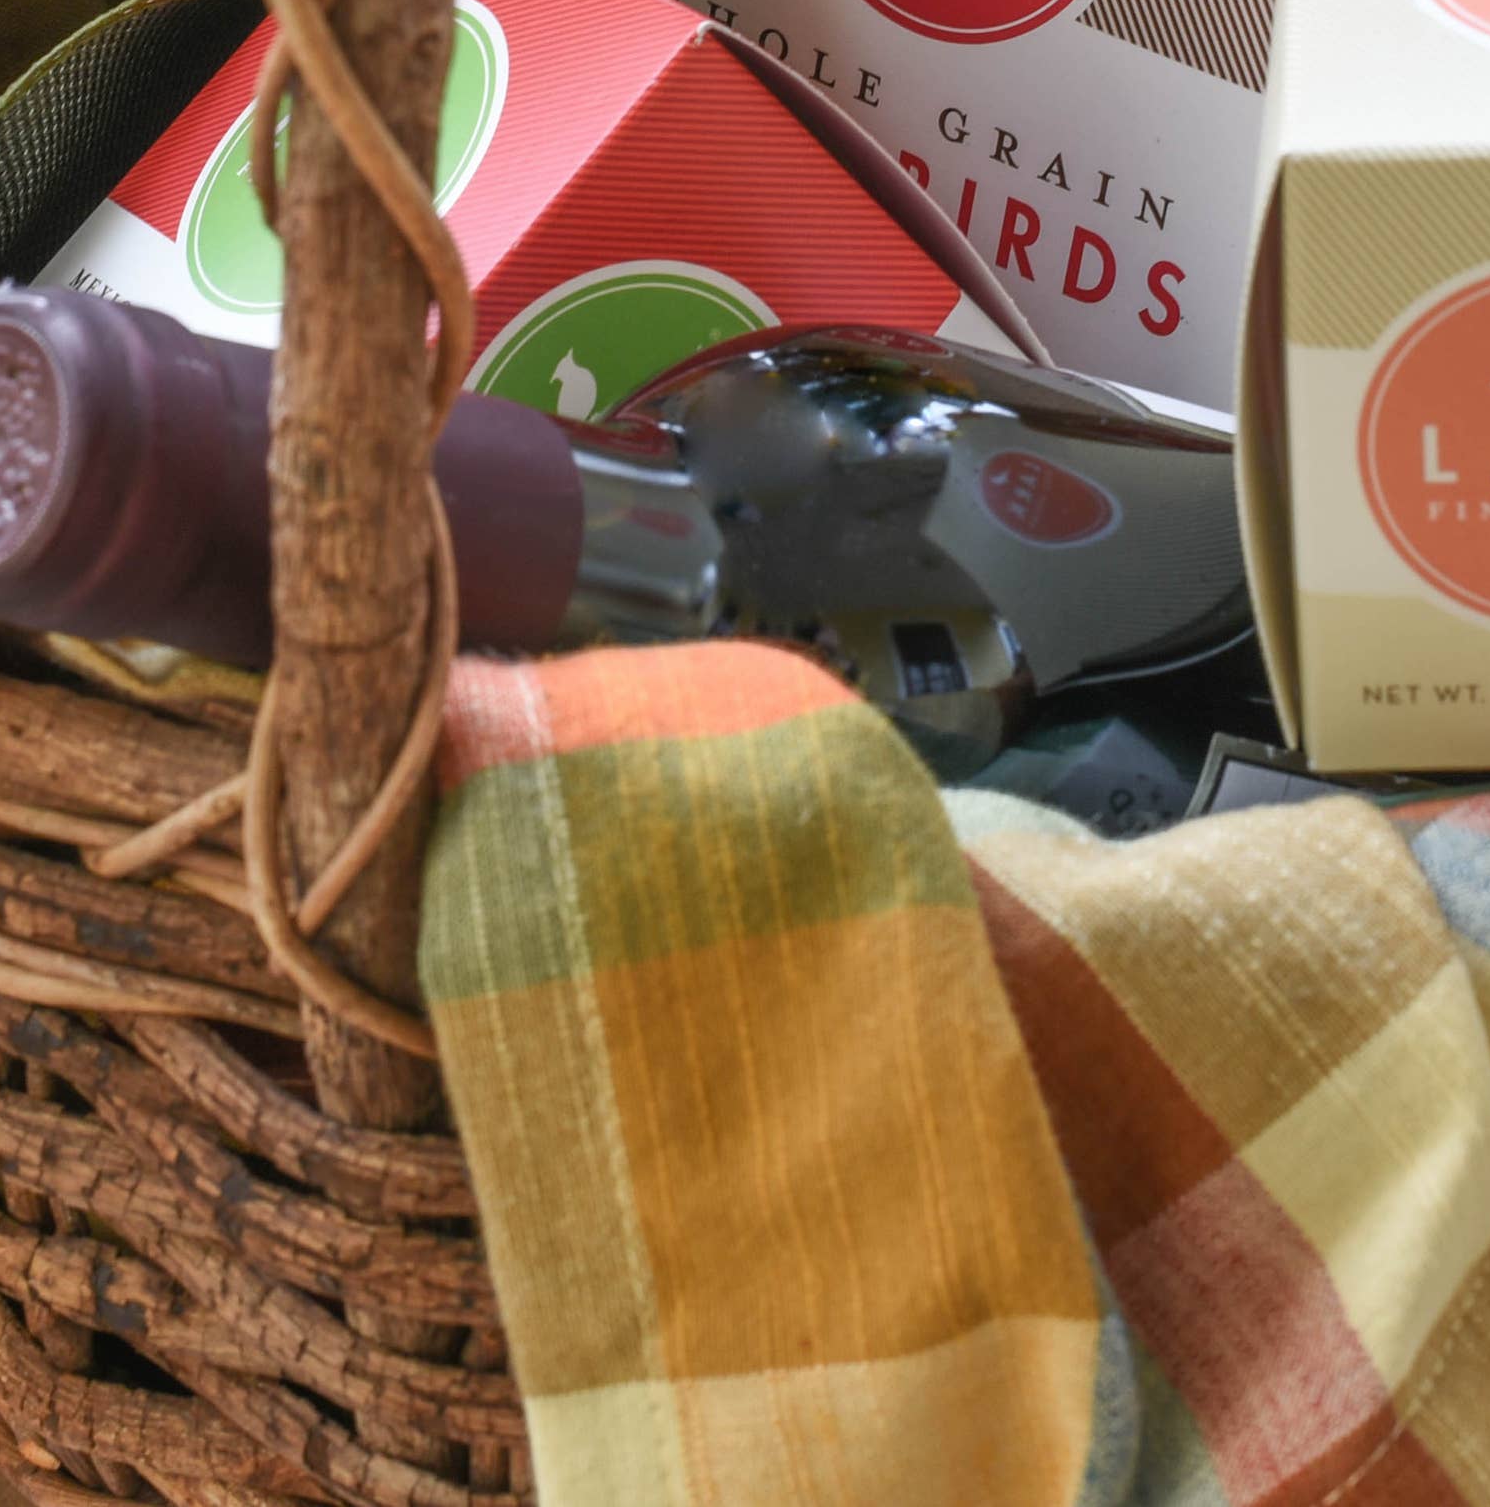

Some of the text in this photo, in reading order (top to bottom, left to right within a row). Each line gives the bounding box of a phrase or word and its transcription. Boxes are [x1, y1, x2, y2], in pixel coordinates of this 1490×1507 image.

[938, 107, 1174, 231] GRAIN
[1363, 683, 1487, 705] NET WT.
